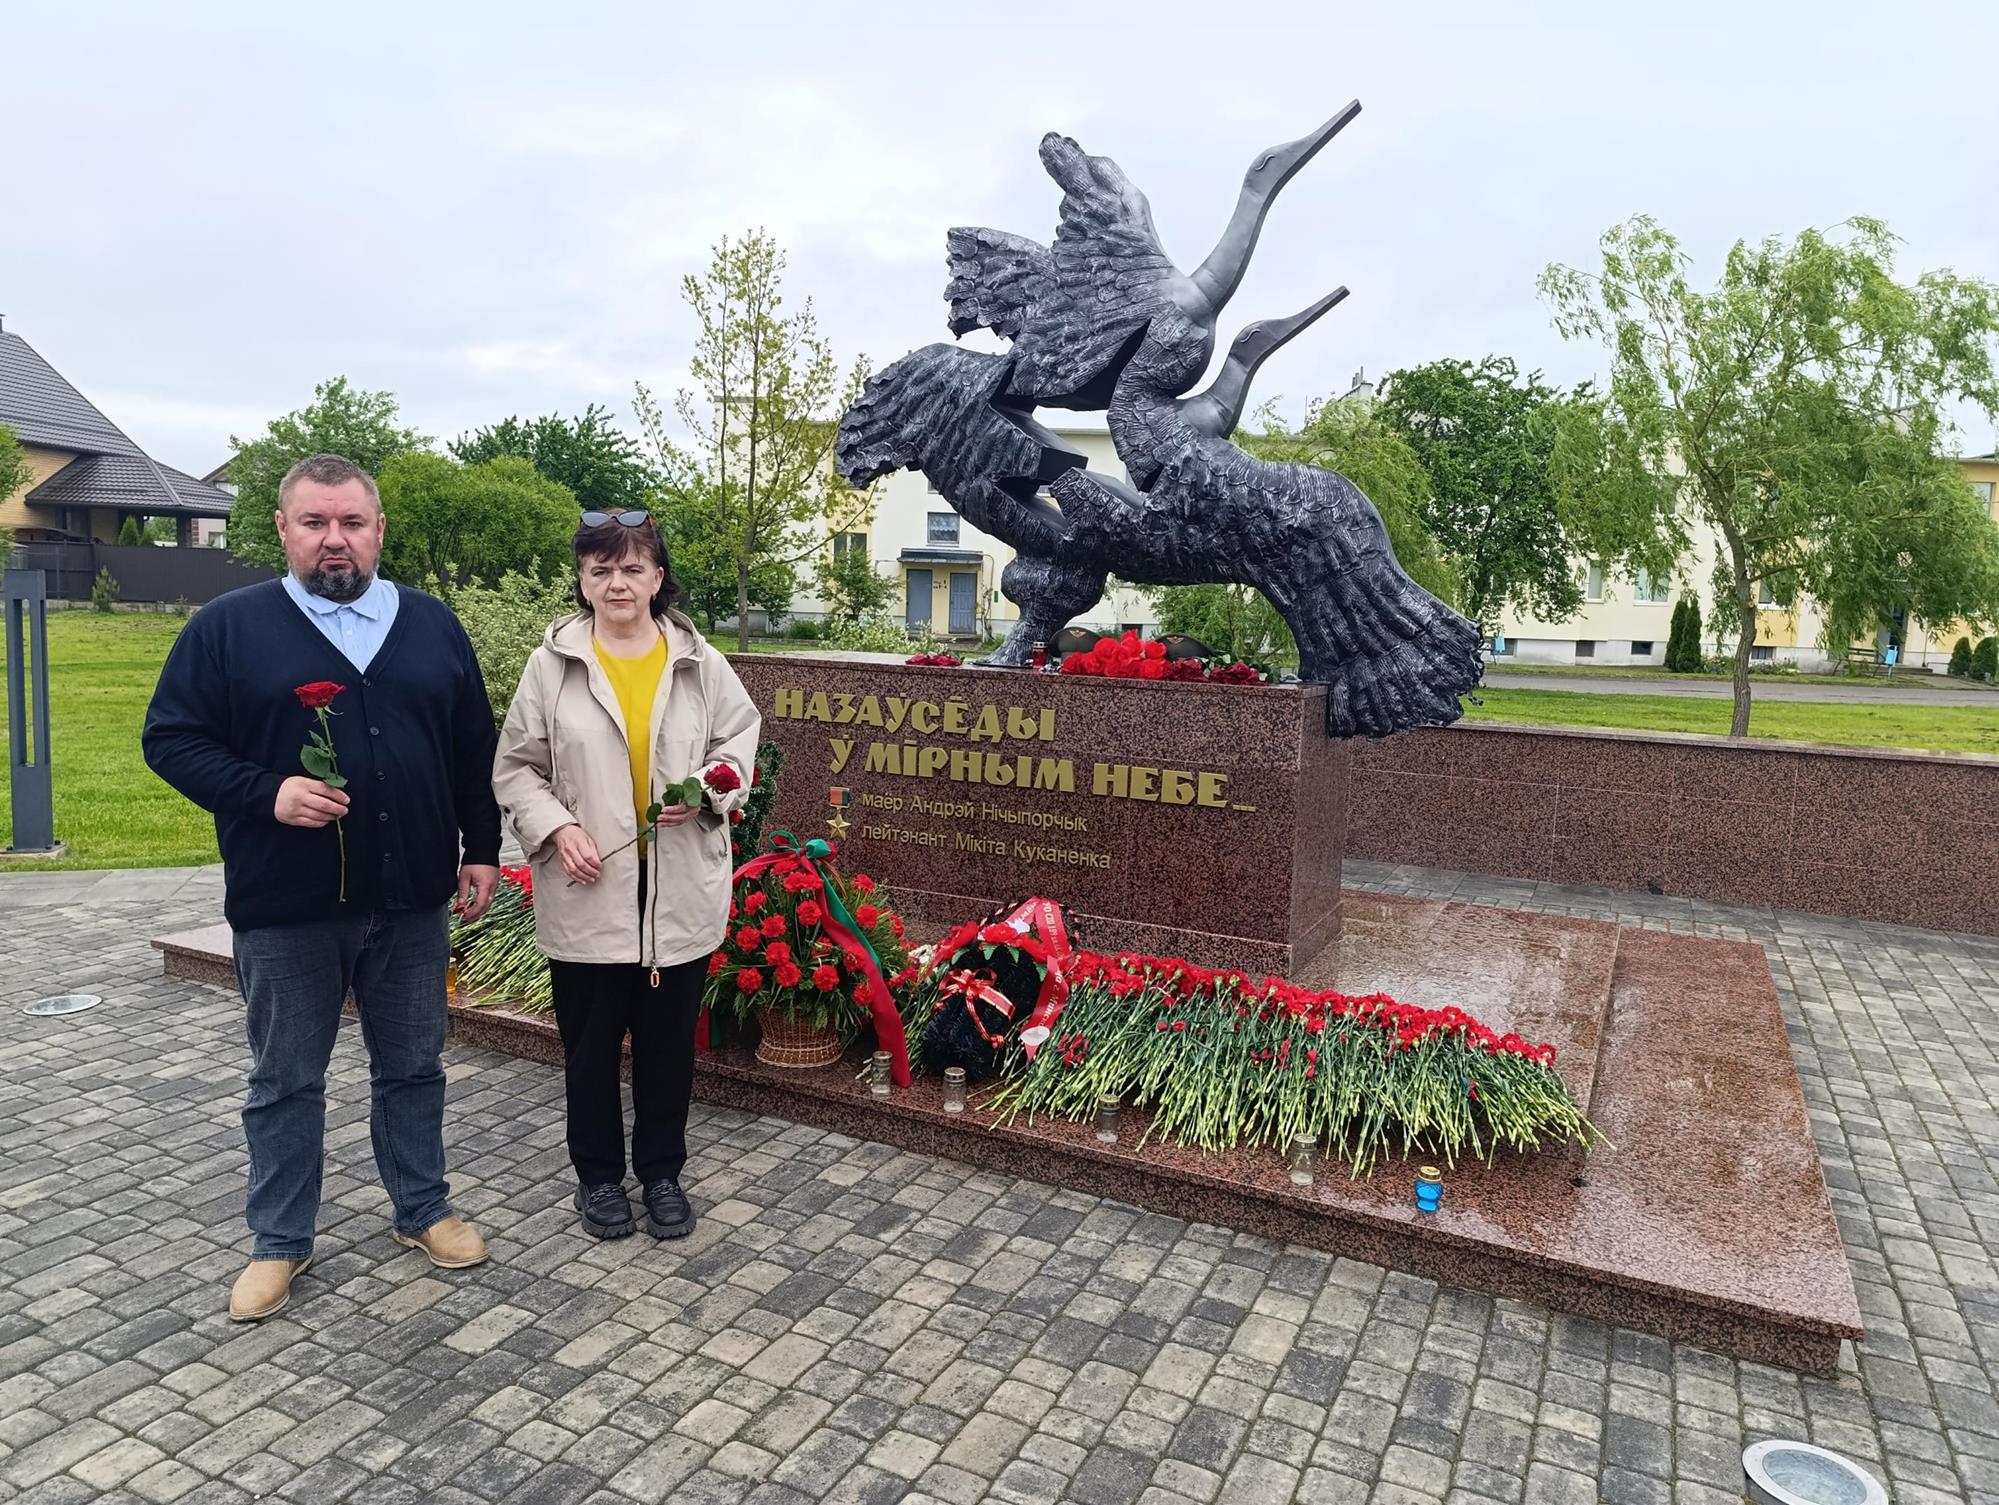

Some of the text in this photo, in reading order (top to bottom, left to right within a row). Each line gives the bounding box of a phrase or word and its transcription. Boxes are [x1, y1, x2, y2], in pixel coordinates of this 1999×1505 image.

[775, 688, 1056, 743] НАЗАЎСЁДЫ
[829, 735, 855, 774] Ў
[864, 740, 1075, 793] МІРНЫМ
[862, 792, 1088, 832] маёр Андрэй Нічыпорчык
[861, 822, 1111, 869] лейтэнант Мікіта Куканенка
